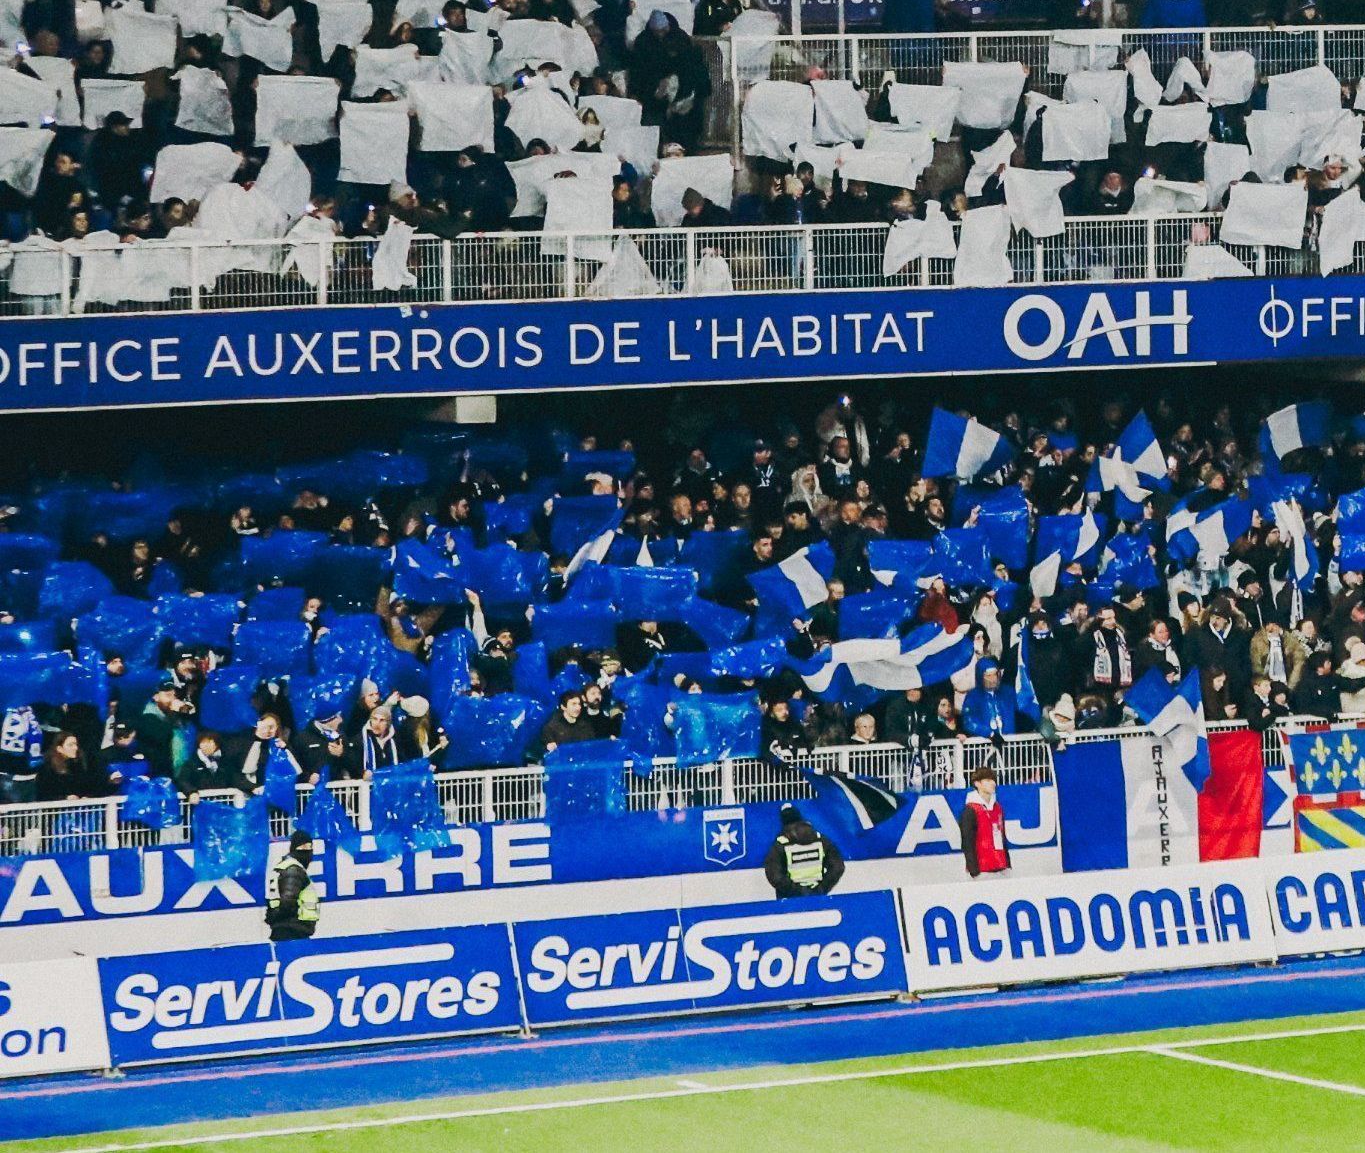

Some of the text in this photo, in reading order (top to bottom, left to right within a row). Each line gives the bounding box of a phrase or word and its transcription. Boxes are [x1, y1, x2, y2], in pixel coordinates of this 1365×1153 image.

[0, 337, 181, 387] FFICE
[204, 325, 545, 379] AUXERROIS
[568, 321, 641, 366] DE
[667, 310, 935, 362] L'HABITAT
[1002, 289, 1195, 363] OAH
[527, 908, 888, 1011] ServiStores
[922, 882, 1252, 968] ACADOMIA
[109, 942, 502, 1050] ServiStores
